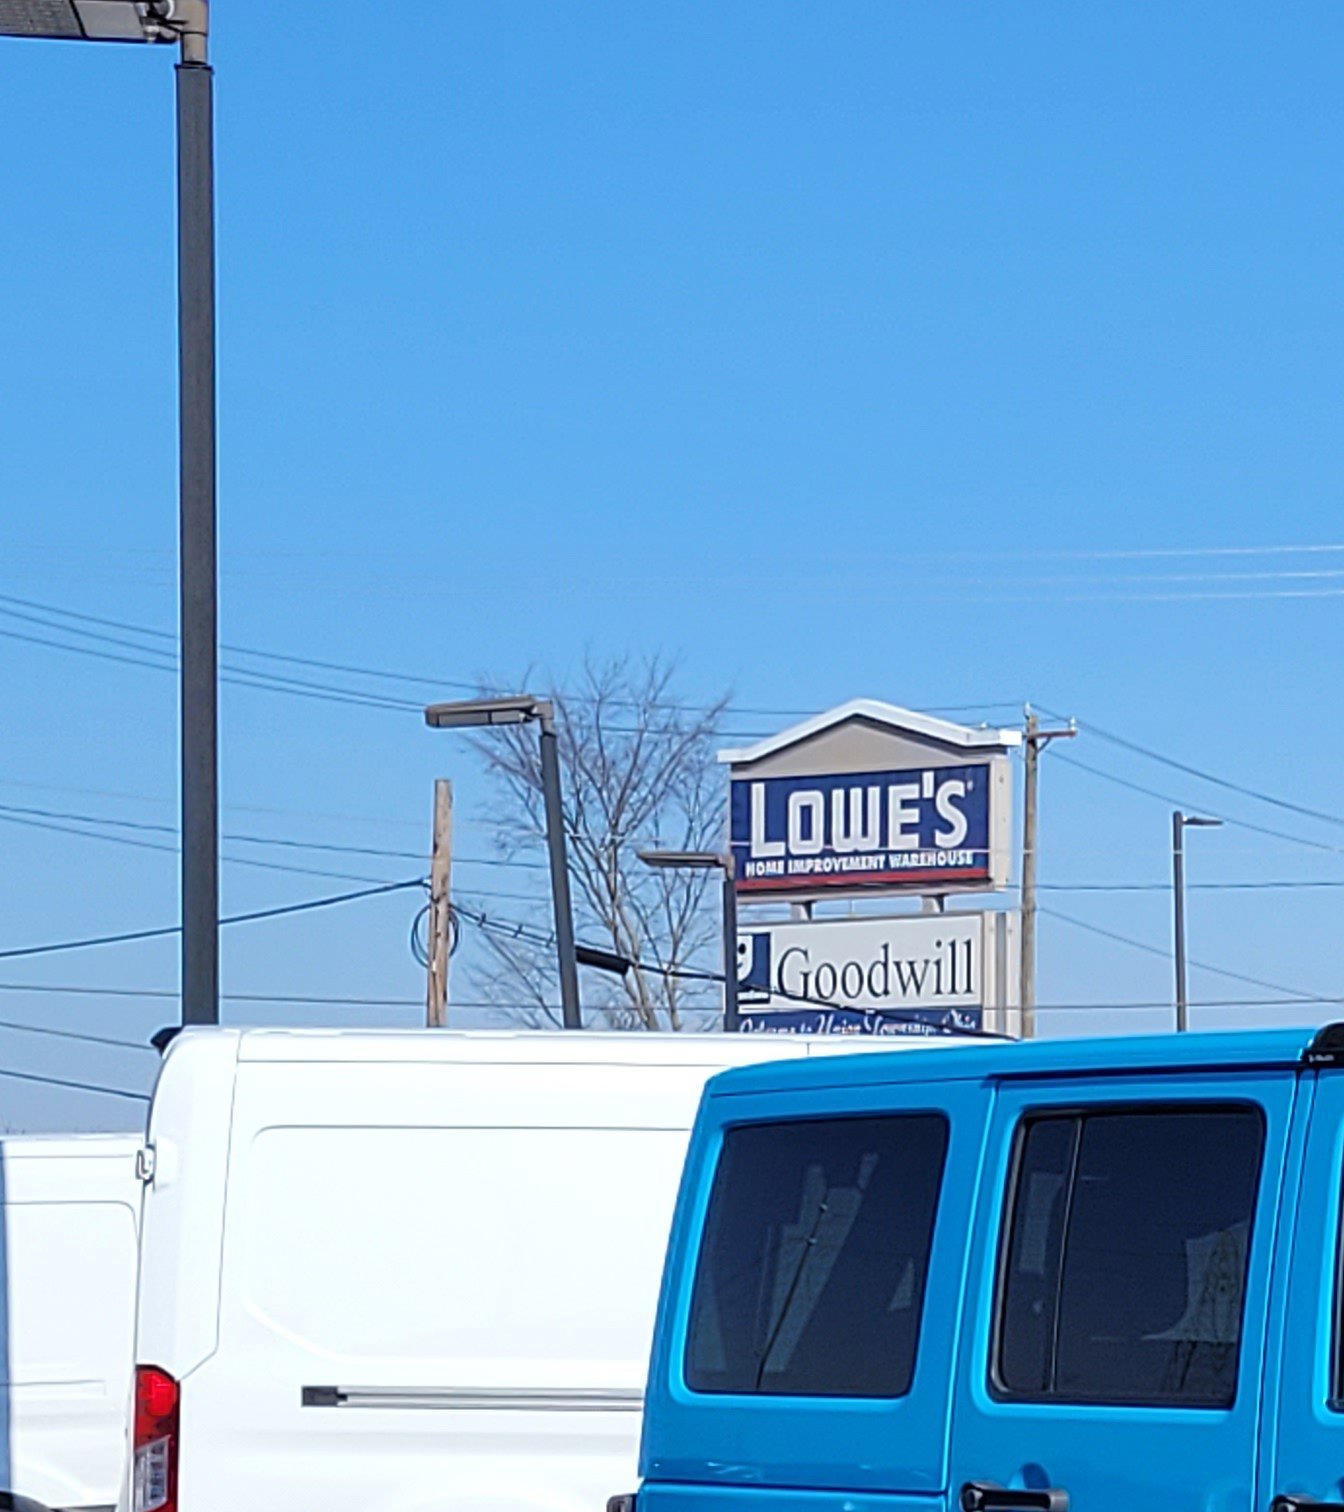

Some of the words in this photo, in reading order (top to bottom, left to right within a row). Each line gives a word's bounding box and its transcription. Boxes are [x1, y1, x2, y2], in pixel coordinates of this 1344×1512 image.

[751, 771, 968, 858] LOWE'S
[745, 860, 785, 878] HOME
[787, 854, 886, 875] IMPROVEMENT
[888, 850, 974, 869] WAREHOUSE
[777, 938, 974, 1001] Goodwill
